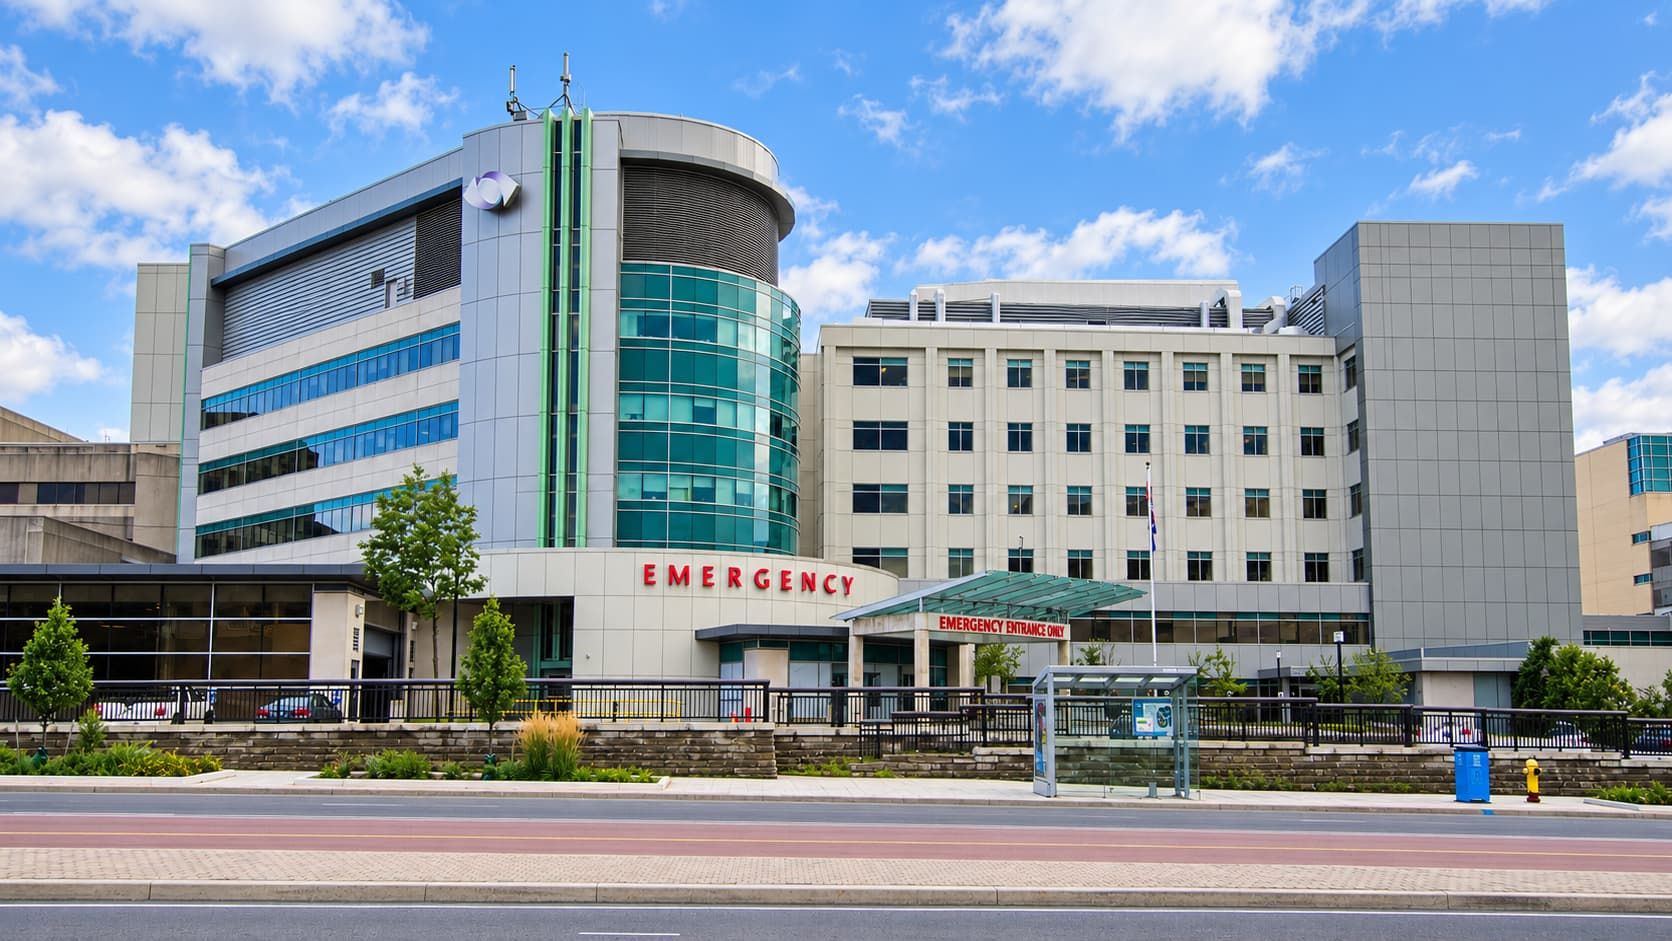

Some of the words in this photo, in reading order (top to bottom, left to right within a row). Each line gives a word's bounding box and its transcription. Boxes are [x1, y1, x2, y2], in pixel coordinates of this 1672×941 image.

[643, 563, 854, 596] EMERGENCY
[939, 615, 1004, 633] EMERGENCY
[1006, 621, 1046, 637] ENTRANCE
[1047, 625, 1065, 638] ONLY
